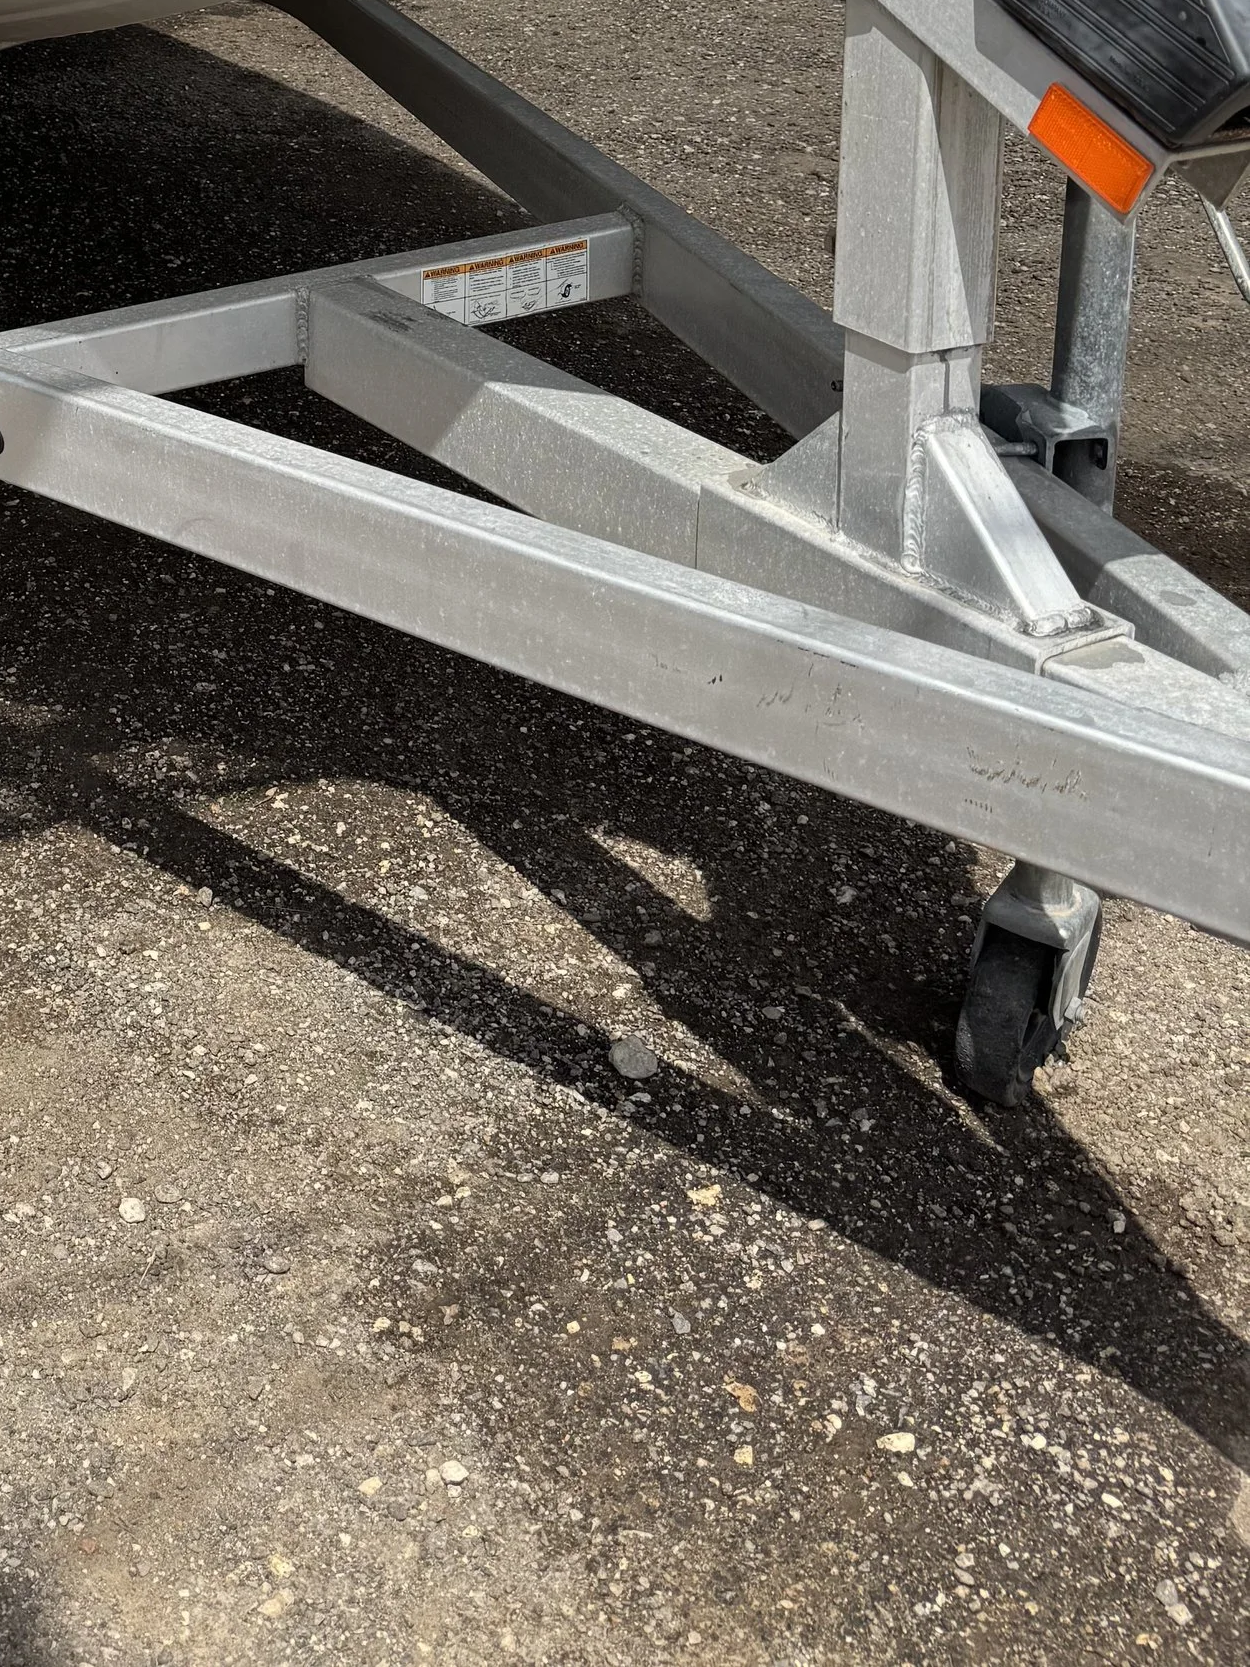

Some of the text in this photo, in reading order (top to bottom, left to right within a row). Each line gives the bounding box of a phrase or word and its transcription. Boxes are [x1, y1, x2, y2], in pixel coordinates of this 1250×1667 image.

[555, 242, 584, 254] WARNING
[513, 251, 543, 263] WARNING
[474, 259, 504, 271] WARNING
[430, 266, 460, 278] WARNING
